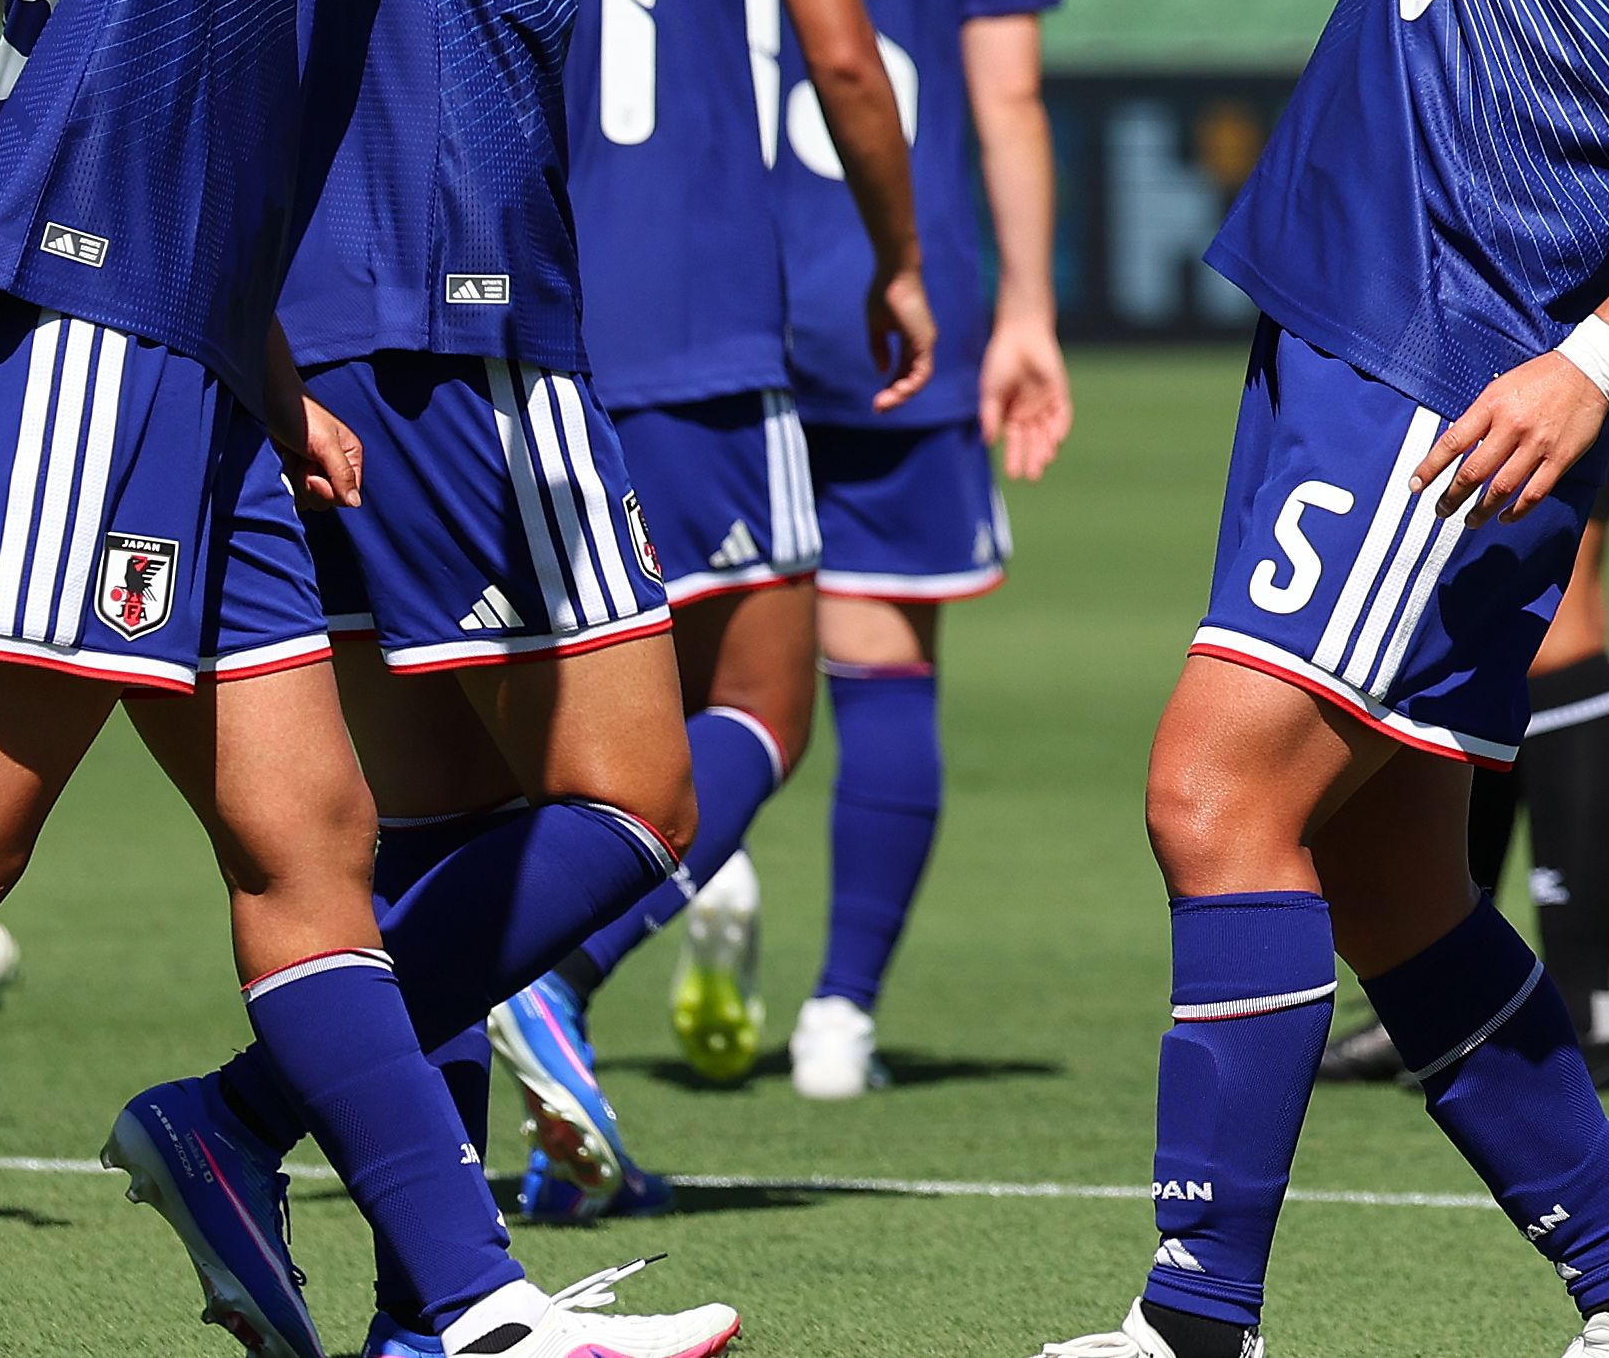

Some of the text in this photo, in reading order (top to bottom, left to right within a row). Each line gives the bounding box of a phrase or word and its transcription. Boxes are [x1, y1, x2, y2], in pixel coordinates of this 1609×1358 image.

[122, 539, 161, 552] JAPAN
[1249, 480, 1355, 615] 5
[116, 605, 147, 621] JFA
[1520, 1203, 1571, 1241] AN
